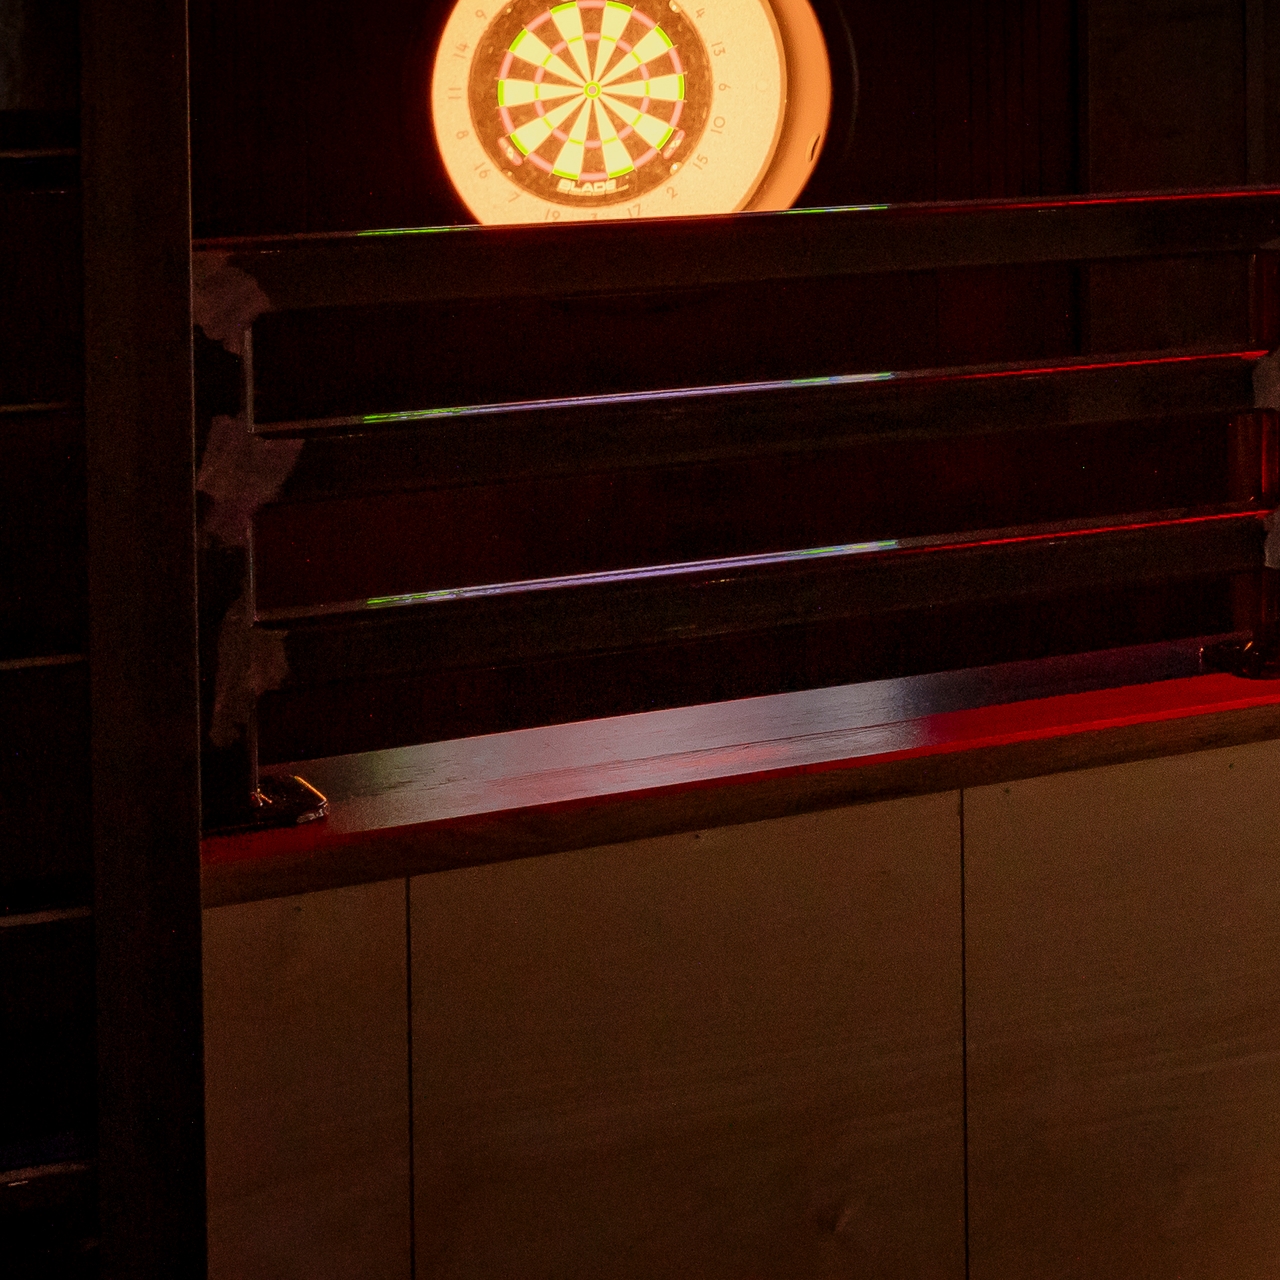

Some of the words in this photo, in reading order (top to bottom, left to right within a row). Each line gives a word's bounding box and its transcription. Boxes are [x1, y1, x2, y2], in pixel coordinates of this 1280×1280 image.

[695, 7, 706, 19] 4
[453, 42, 470, 59] 14
[711, 41, 726, 57] 13
[448, 87, 462, 100] 11
[710, 116, 726, 134] 10
[456, 130, 469, 140] 8
[693, 153, 709, 170] 15
[474, 162, 491, 179] 16
[557, 179, 617, 196] BLADE
[666, 186, 679, 200] 2
[627, 204, 641, 218] 17
